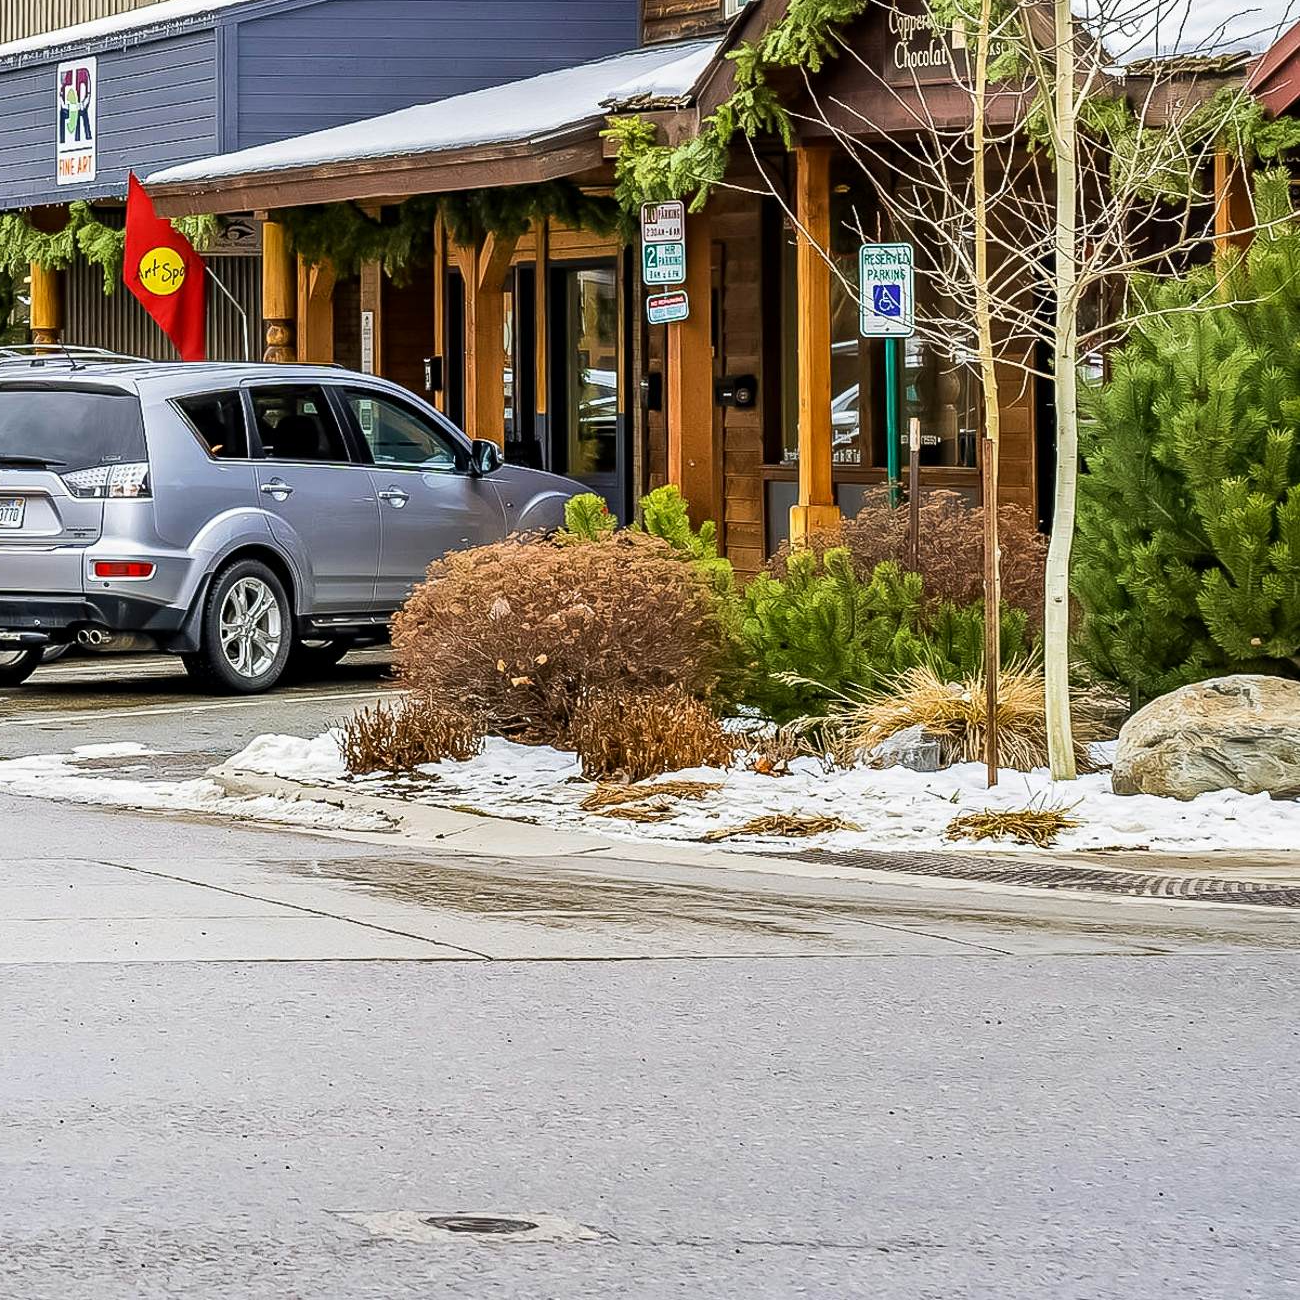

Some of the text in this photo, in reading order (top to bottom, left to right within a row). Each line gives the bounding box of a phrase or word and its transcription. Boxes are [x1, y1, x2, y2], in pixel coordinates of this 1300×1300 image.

[894, 39, 948, 69] Chocolat
[59, 155, 92, 176] FINE ART
[647, 247, 656, 267] 2
[864, 253, 911, 265] RESERVED
[867, 269, 906, 280] PARKING
